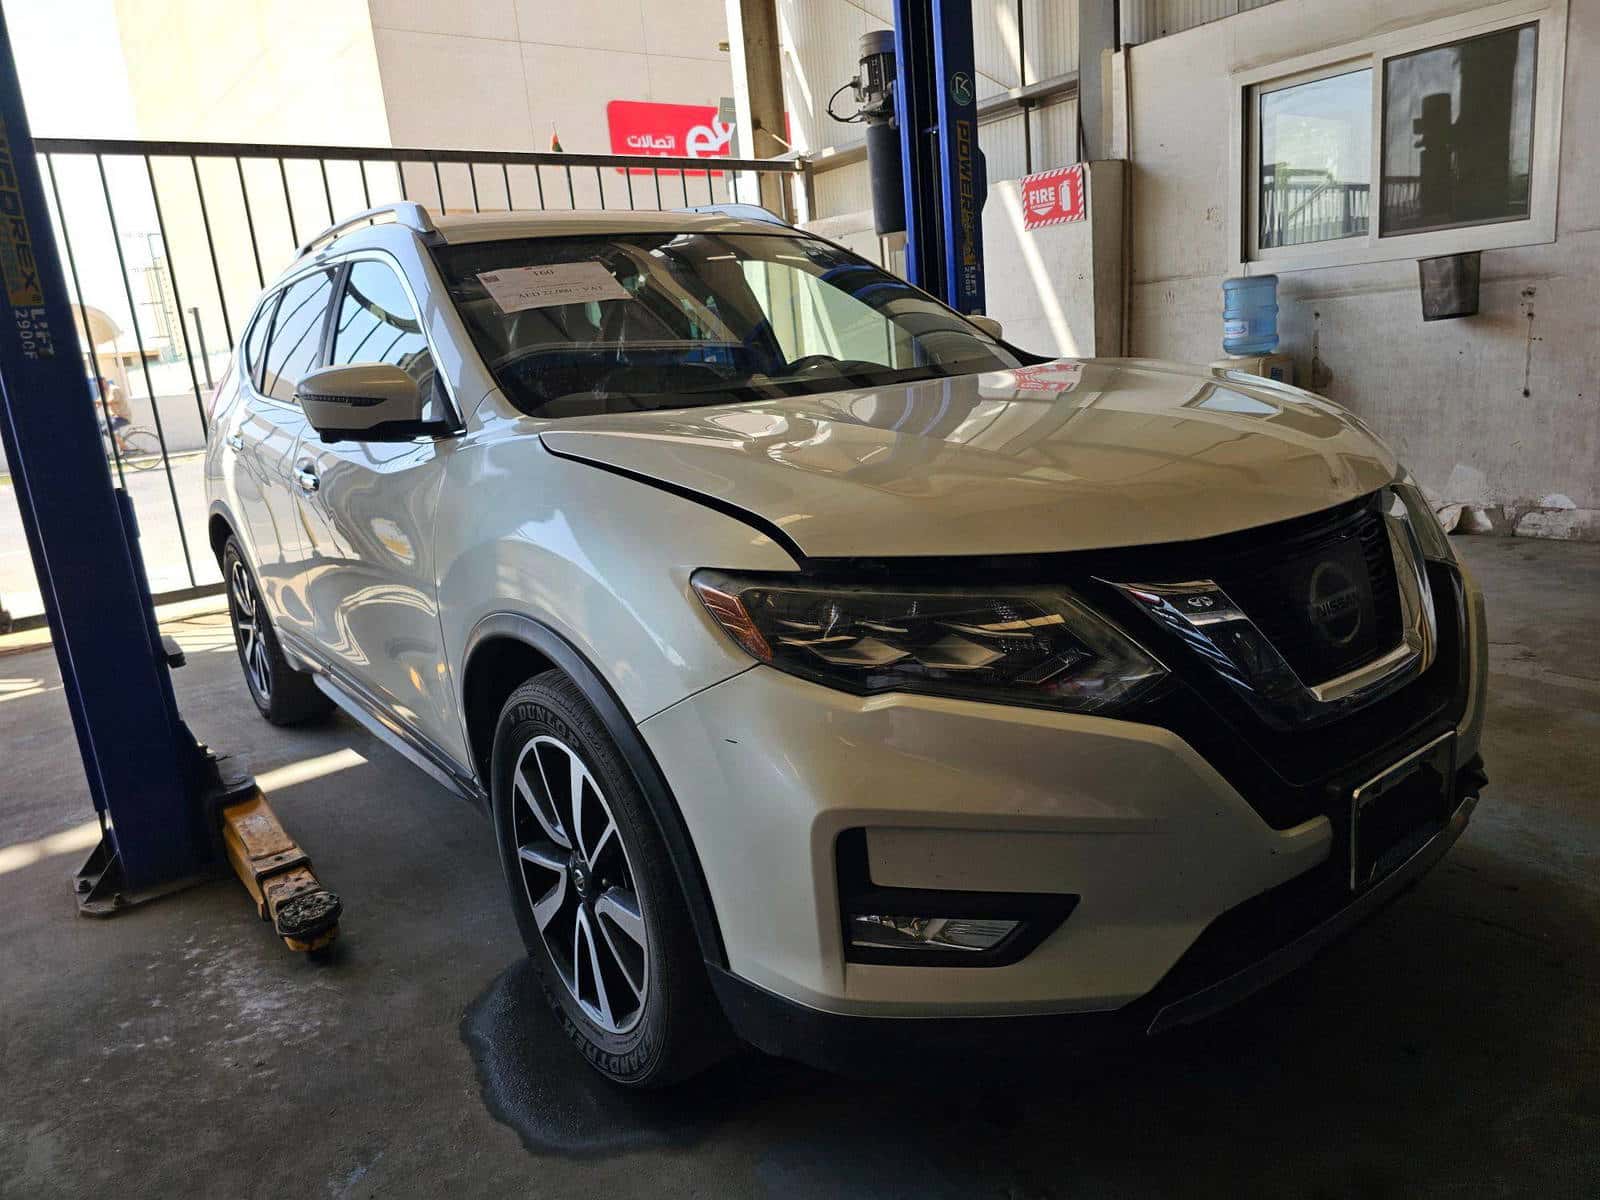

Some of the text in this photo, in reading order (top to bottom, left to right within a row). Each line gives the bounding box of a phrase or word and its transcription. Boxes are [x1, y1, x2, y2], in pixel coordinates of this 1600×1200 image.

[626, 133, 676, 149] اتصالات
[1029, 187, 1056, 205] FIRE
[31, 306, 54, 357] LIFT
[518, 704, 580, 748] DUNLOP
